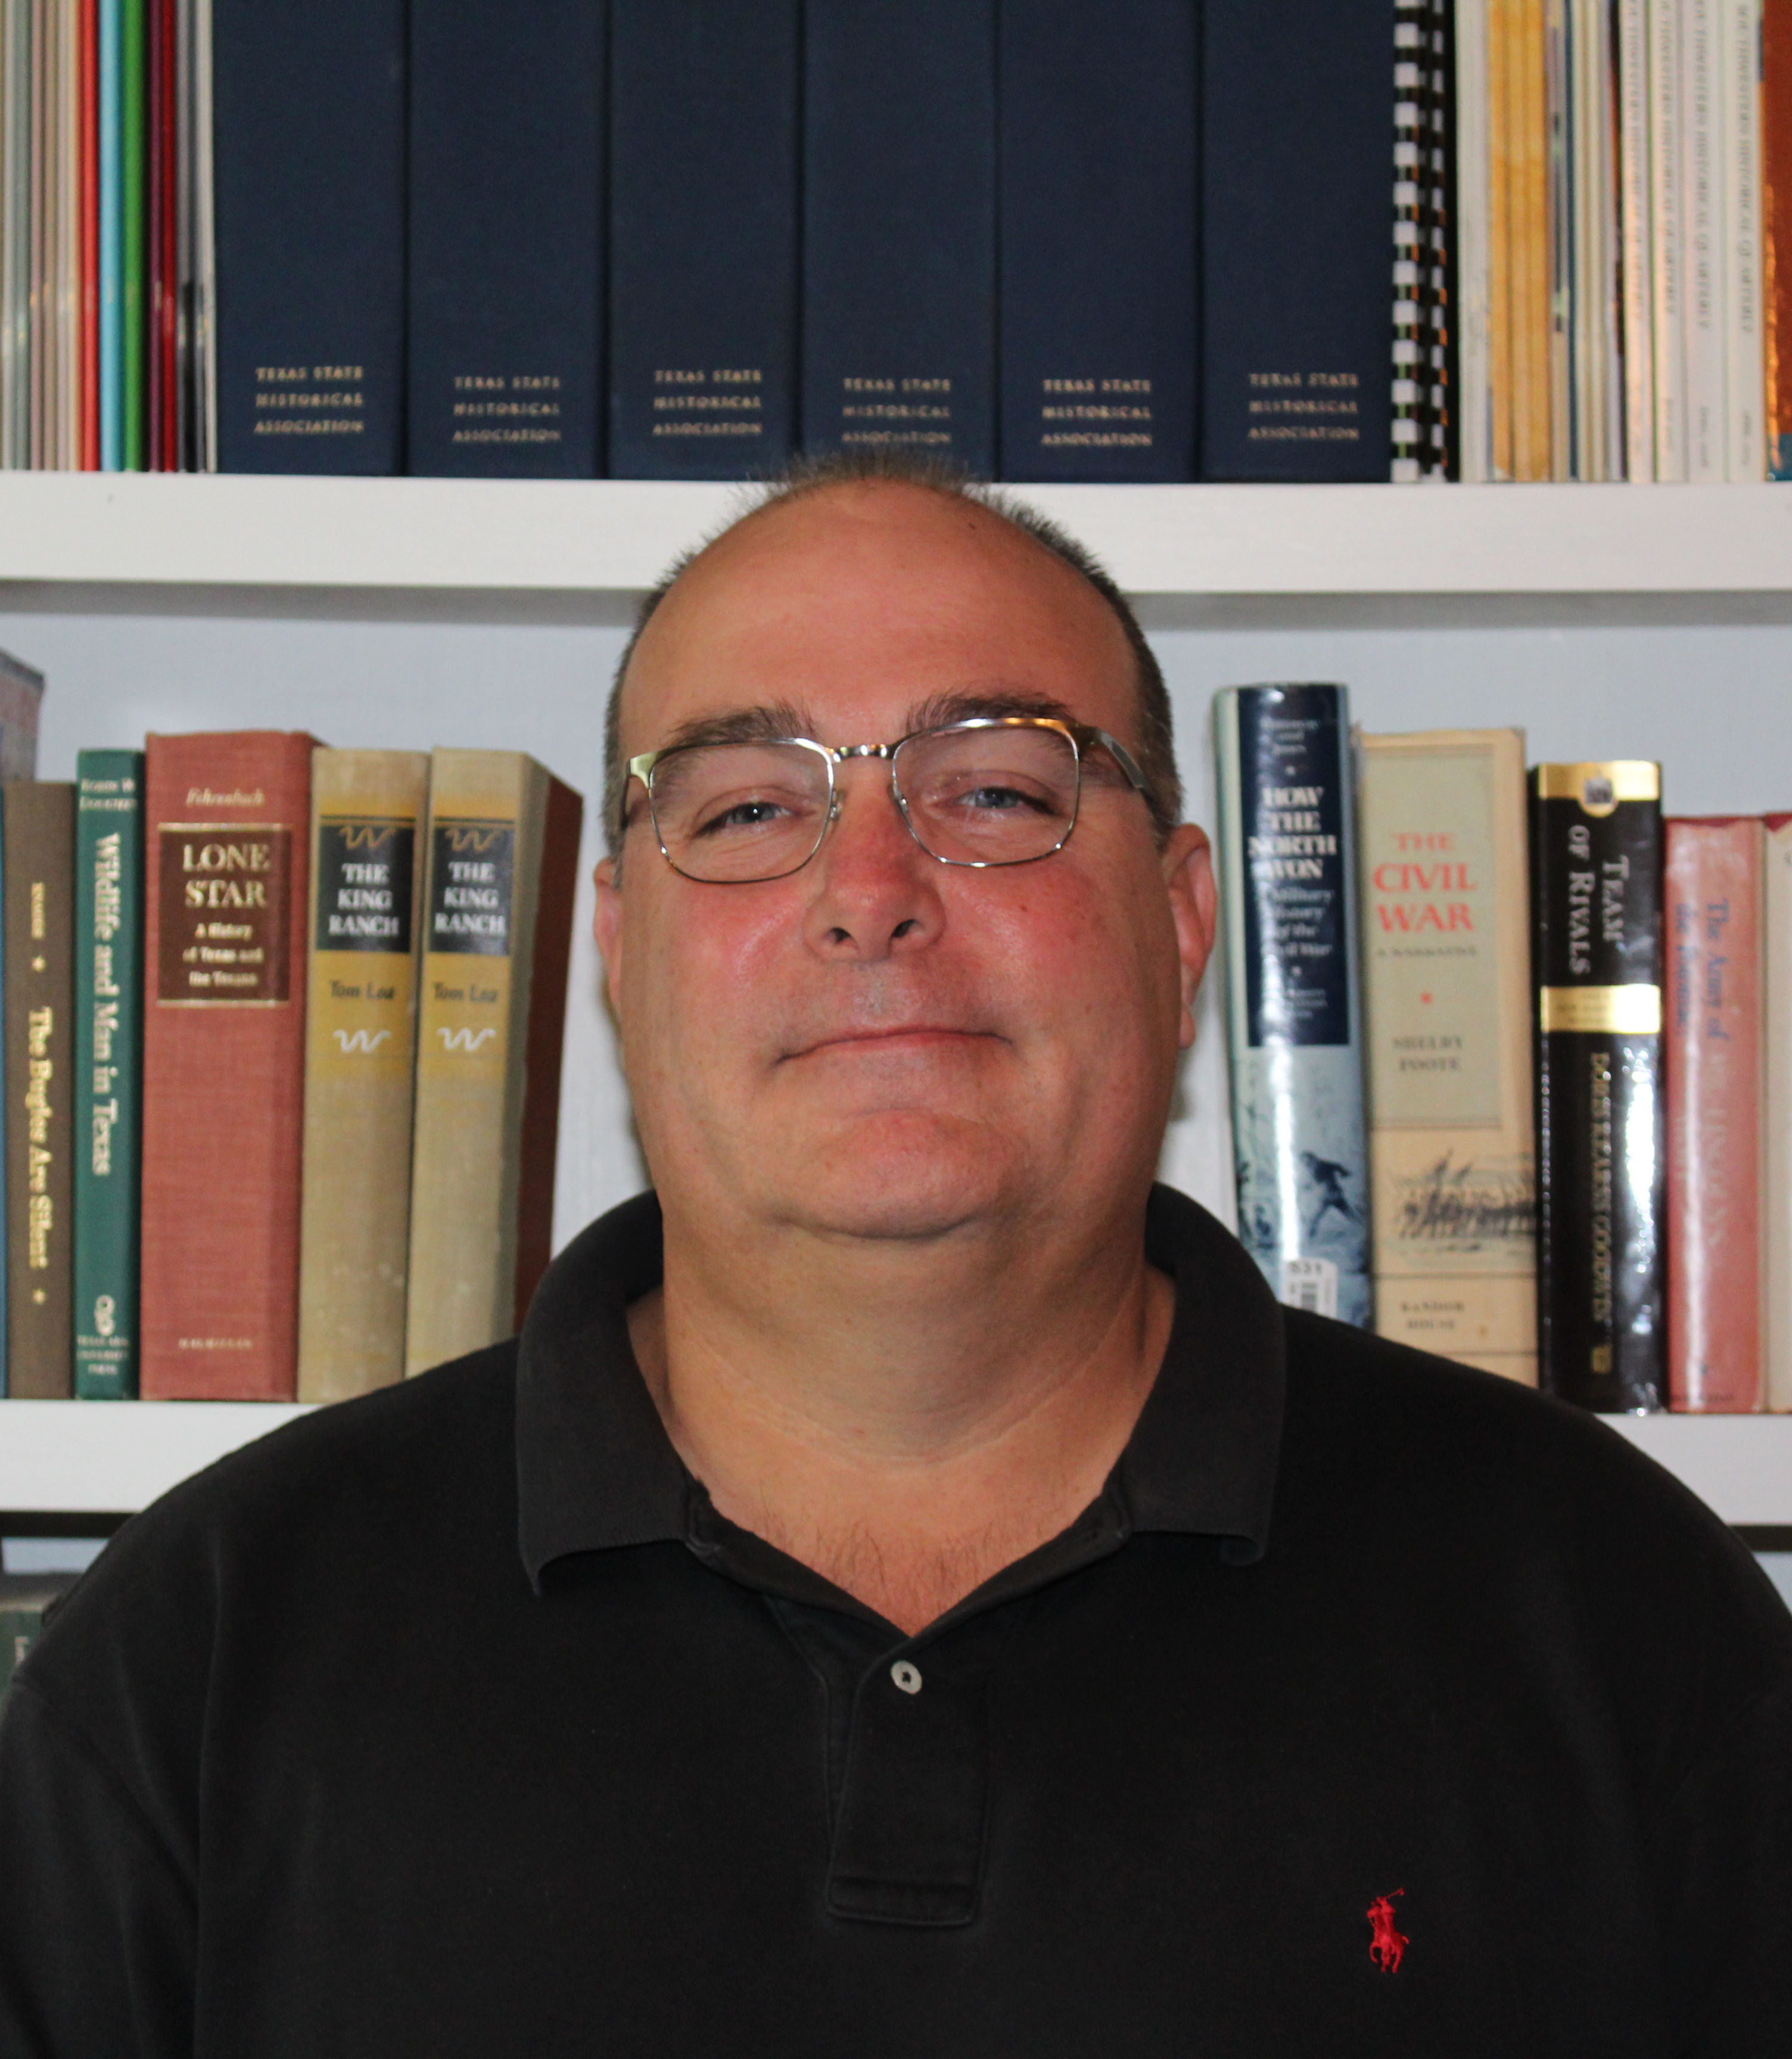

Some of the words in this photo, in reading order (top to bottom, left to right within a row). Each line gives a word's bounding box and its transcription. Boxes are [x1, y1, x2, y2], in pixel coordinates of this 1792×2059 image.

[256, 367, 307, 382] TEXAS
[313, 366, 363, 381] STATE
[454, 377, 505, 390] TEXAS
[513, 377, 561, 390] STATE
[655, 370, 705, 382] TEXAS
[712, 370, 762, 382] STATE
[1249, 373, 1301, 387] TEXAS
[1308, 373, 1359, 387] STATE
[844, 378, 895, 391] TEXAS
[901, 378, 951, 391] STATE
[1043, 380, 1094, 392] TEXAS
[1102, 380, 1150, 392] STATE
[256, 393, 363, 408] HISTORICAL
[453, 403, 560, 415] HISTORICAL
[654, 397, 761, 409] HISTORICAL
[1249, 400, 1358, 413] HISTORICAL
[842, 405, 950, 417] HISTORICAL
[1042, 406, 1151, 419] HISTORICAL
[254, 419, 364, 435] ASSOCIATION
[452, 430, 561, 443] ASSOCIATION
[653, 423, 762, 436] ASSOCIATION
[1249, 427, 1359, 440] ASSOCIATION
[841, 432, 951, 444] ASSOCIATION
[1041, 433, 1152, 446] ASSOCIATION
[1262, 787, 1323, 807] HOW
[1268, 811, 1321, 831] THE
[1249, 835, 1336, 856] NORTH
[1392, 833, 1455, 851] THE
[183, 844, 271, 872] LONE
[342, 863, 390, 884] THE
[449, 862, 496, 882] THE
[1251, 859, 1323, 879] WON
[1374, 863, 1478, 891] CIVIL
[94, 832, 120, 940] Wildlife
[185, 881, 267, 908] STAR
[338, 889, 393, 910] KING
[444, 888, 499, 908] KING
[1603, 854, 1629, 943] TEAM
[329, 915, 399, 937] RANCH
[435, 913, 505, 936] RANCH
[1374, 904, 1474, 932] WAR
[1569, 871, 1595, 975] RIVALS
[1707, 898, 1730, 940] The
[195, 923, 206, 938] A
[209, 922, 253, 941] History
[94, 945, 120, 996] and
[1701, 952, 1729, 1009] Army
[331, 981, 360, 998] Tom
[367, 982, 394, 1000] Lea
[434, 982, 464, 1001] Tom
[469, 984, 497, 1002] Lea
[29, 1006, 53, 1058] The
[94, 1003, 118, 1060] Man
[93, 1067, 117, 1094] in
[25, 1060, 53, 1143] Bugles
[92, 1098, 117, 1176] Texas
[29, 1146, 52, 1192] Are
[29, 1195, 53, 1269] Silent
